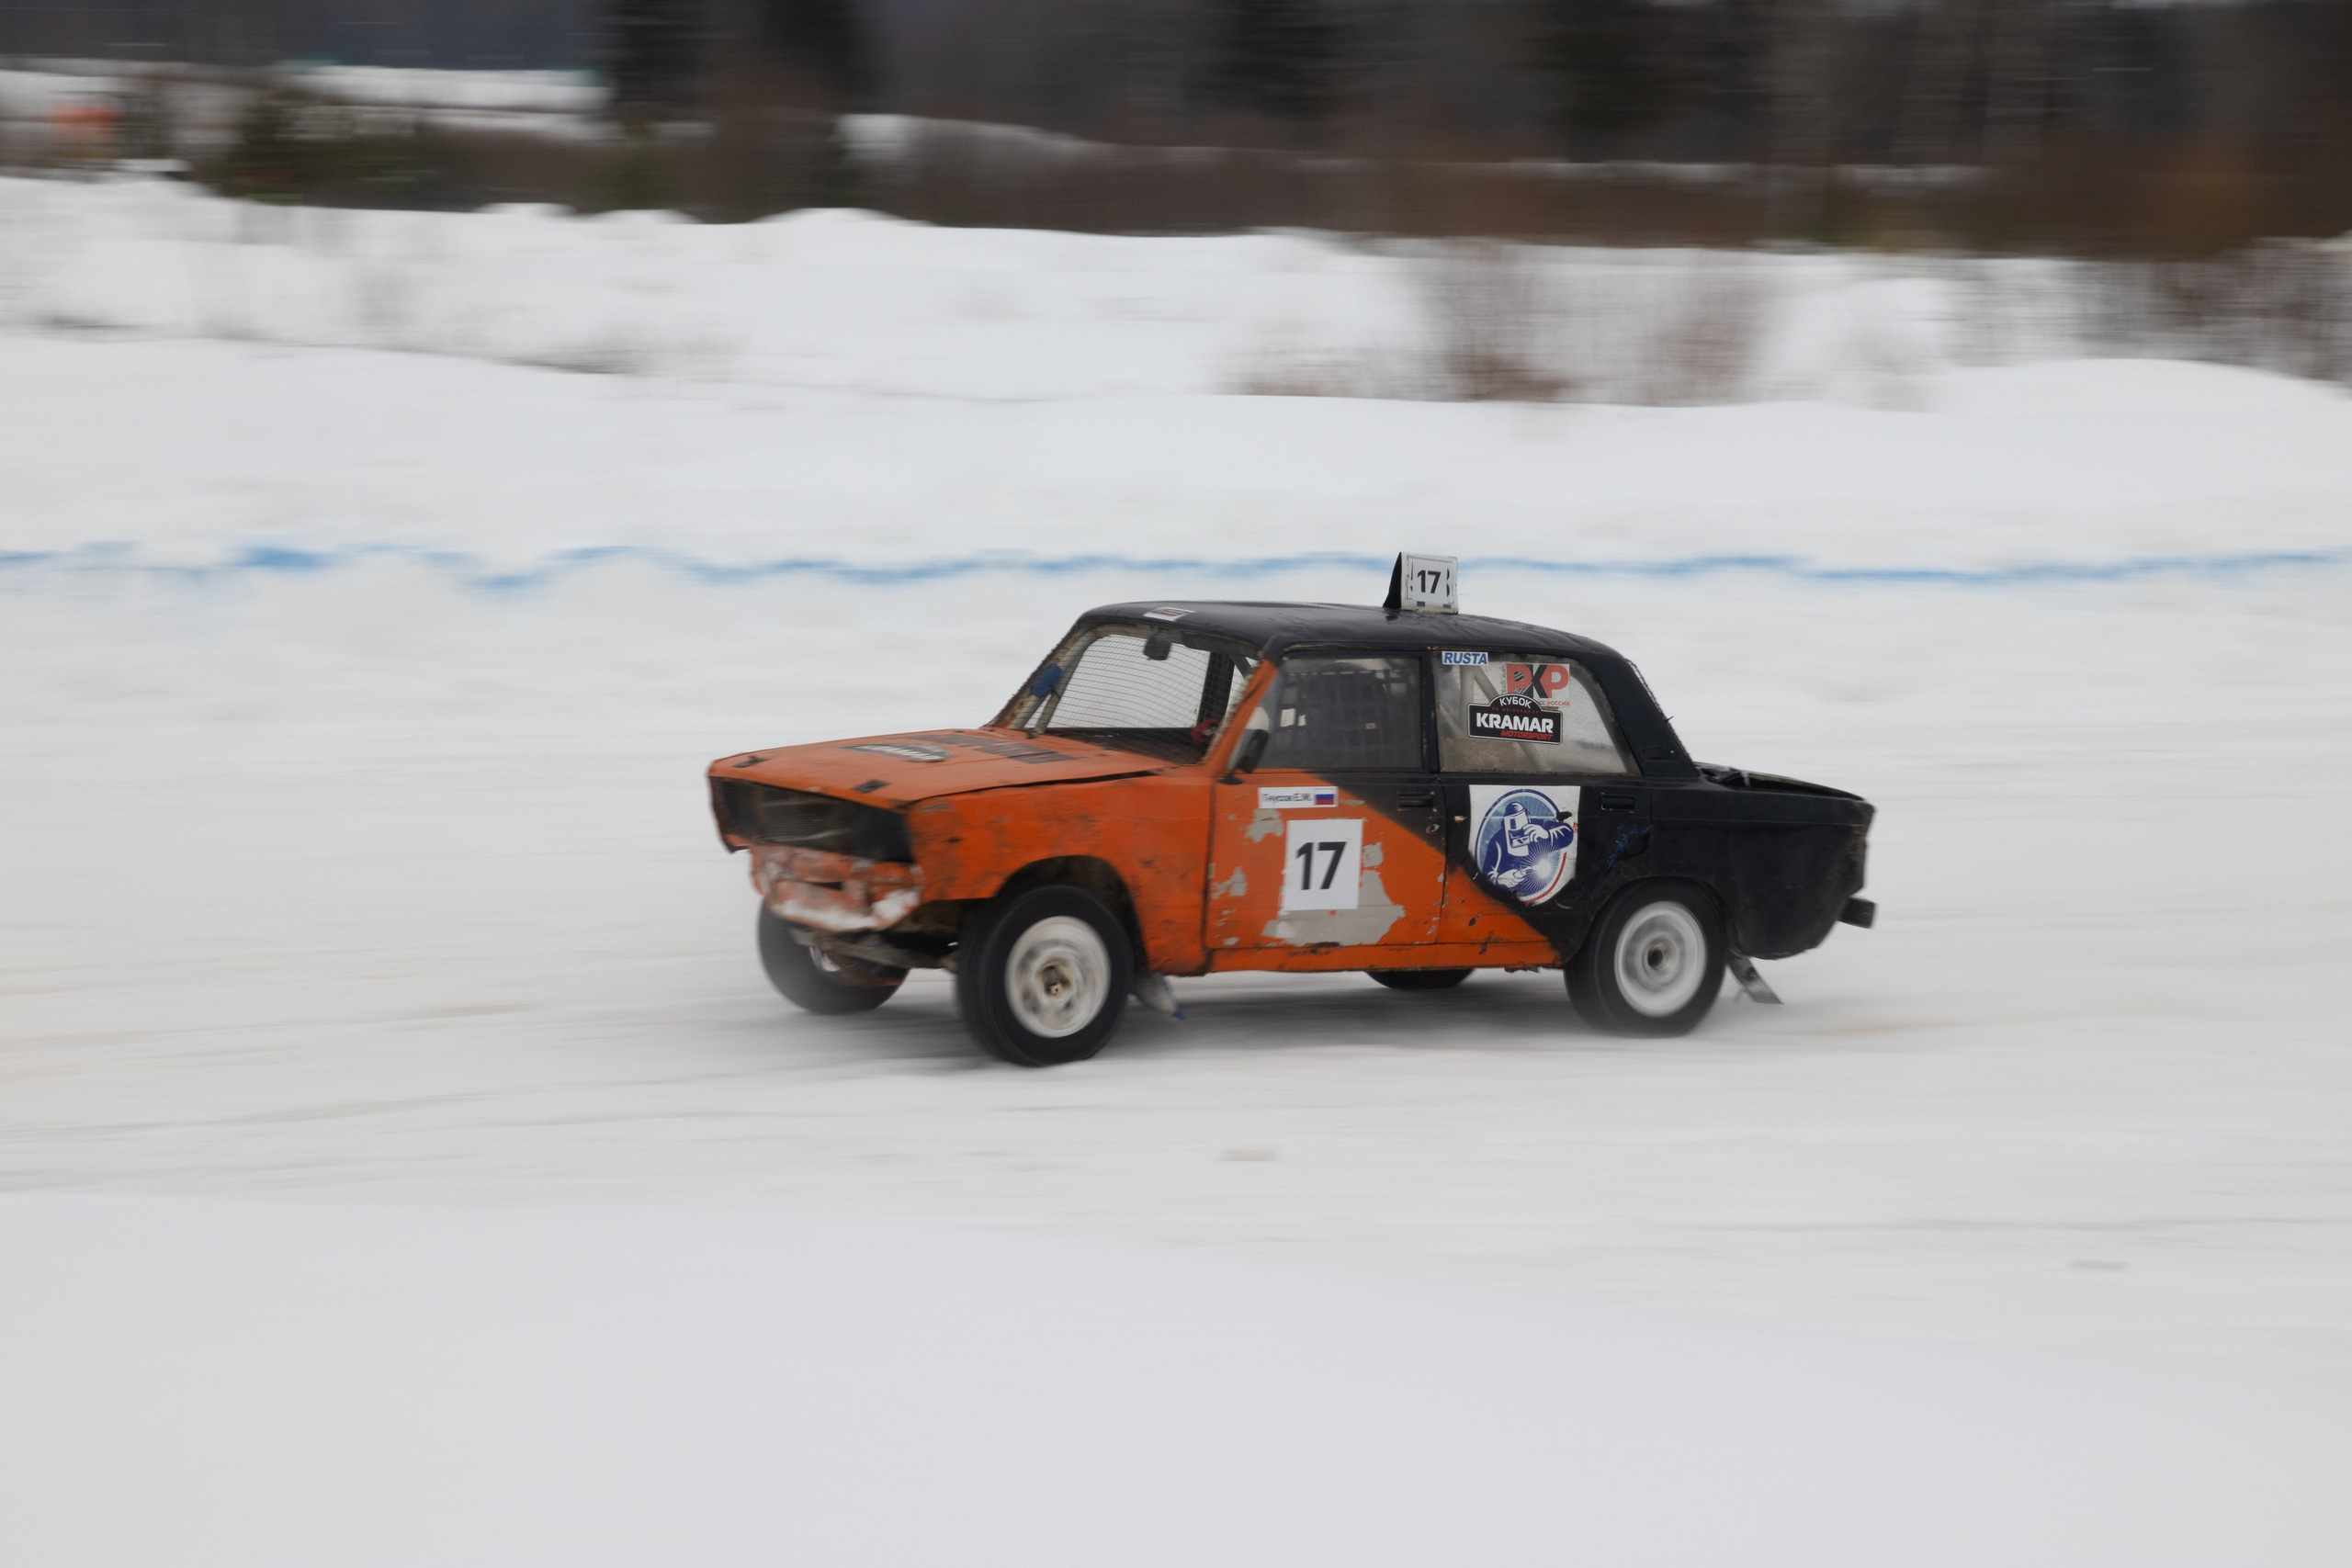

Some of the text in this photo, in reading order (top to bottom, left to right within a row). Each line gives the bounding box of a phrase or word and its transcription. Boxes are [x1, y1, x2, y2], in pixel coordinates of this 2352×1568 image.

[1417, 570, 1442, 594] 17
[1443, 652, 1487, 665] RUSTA
[1499, 696, 1532, 709] КУБОК
[1476, 712, 1554, 734] KRAMAR
[1500, 729, 1554, 740] MOTORSPORT
[1295, 840, 1348, 890] 17
